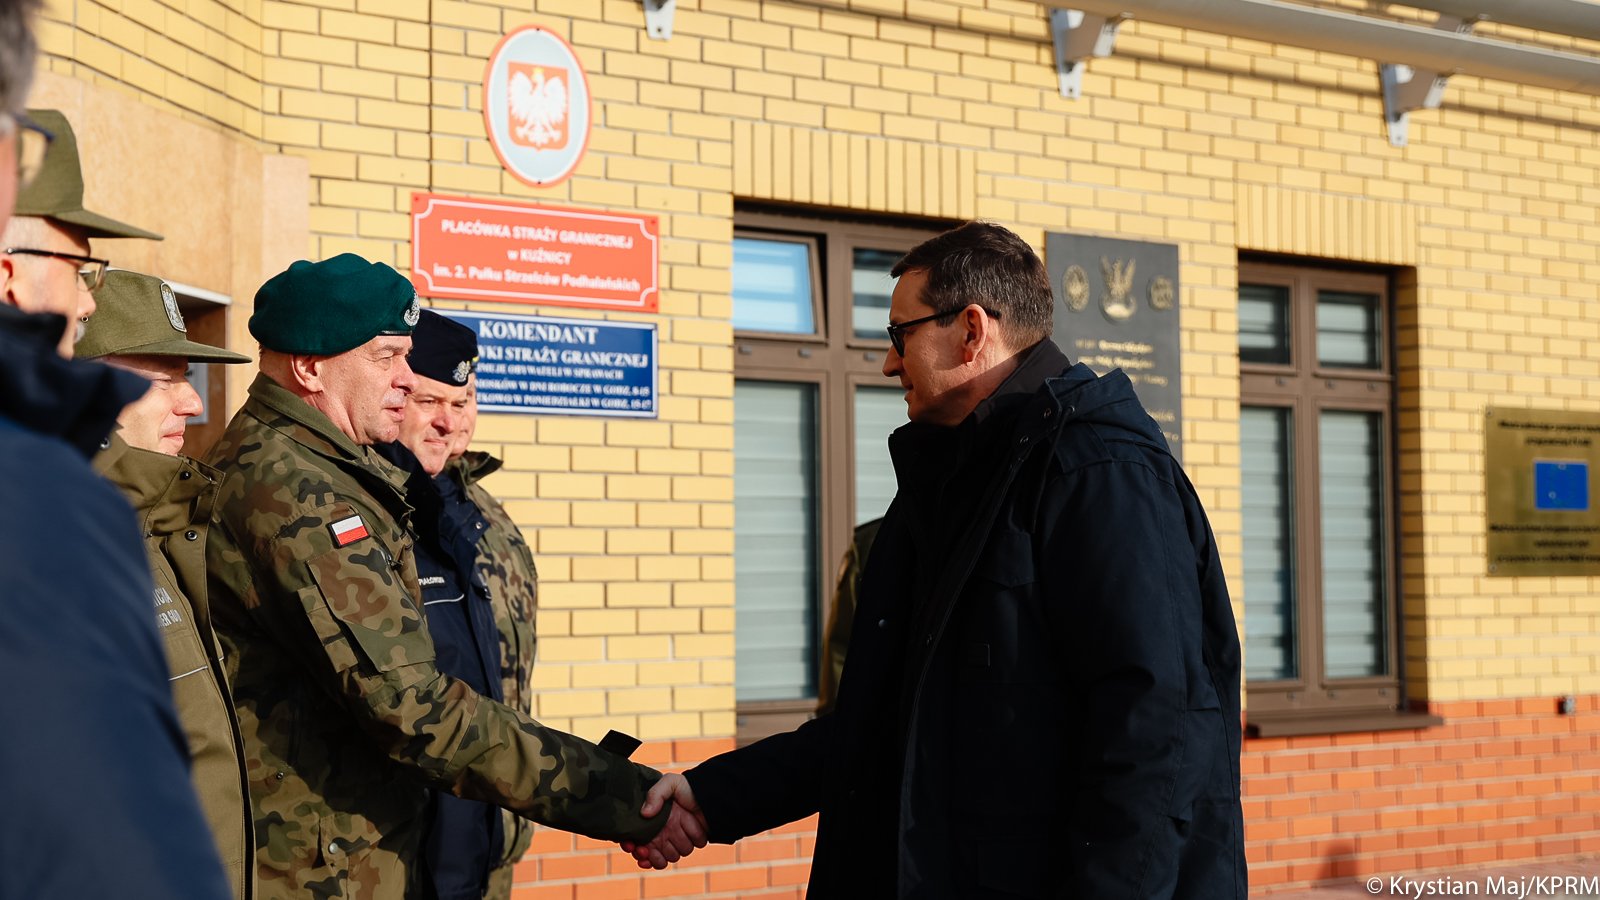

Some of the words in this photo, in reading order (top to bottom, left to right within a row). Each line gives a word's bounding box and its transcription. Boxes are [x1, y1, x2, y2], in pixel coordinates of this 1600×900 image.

[441, 218, 511, 239] PLACÓWKA
[512, 224, 559, 243] STRAŻY
[559, 229, 634, 250] GRANICZNEJ
[479, 320, 599, 345] KOMENDANT
[505, 345, 560, 364] STRAŻY
[561, 350, 648, 369] GRANICZNEJ
